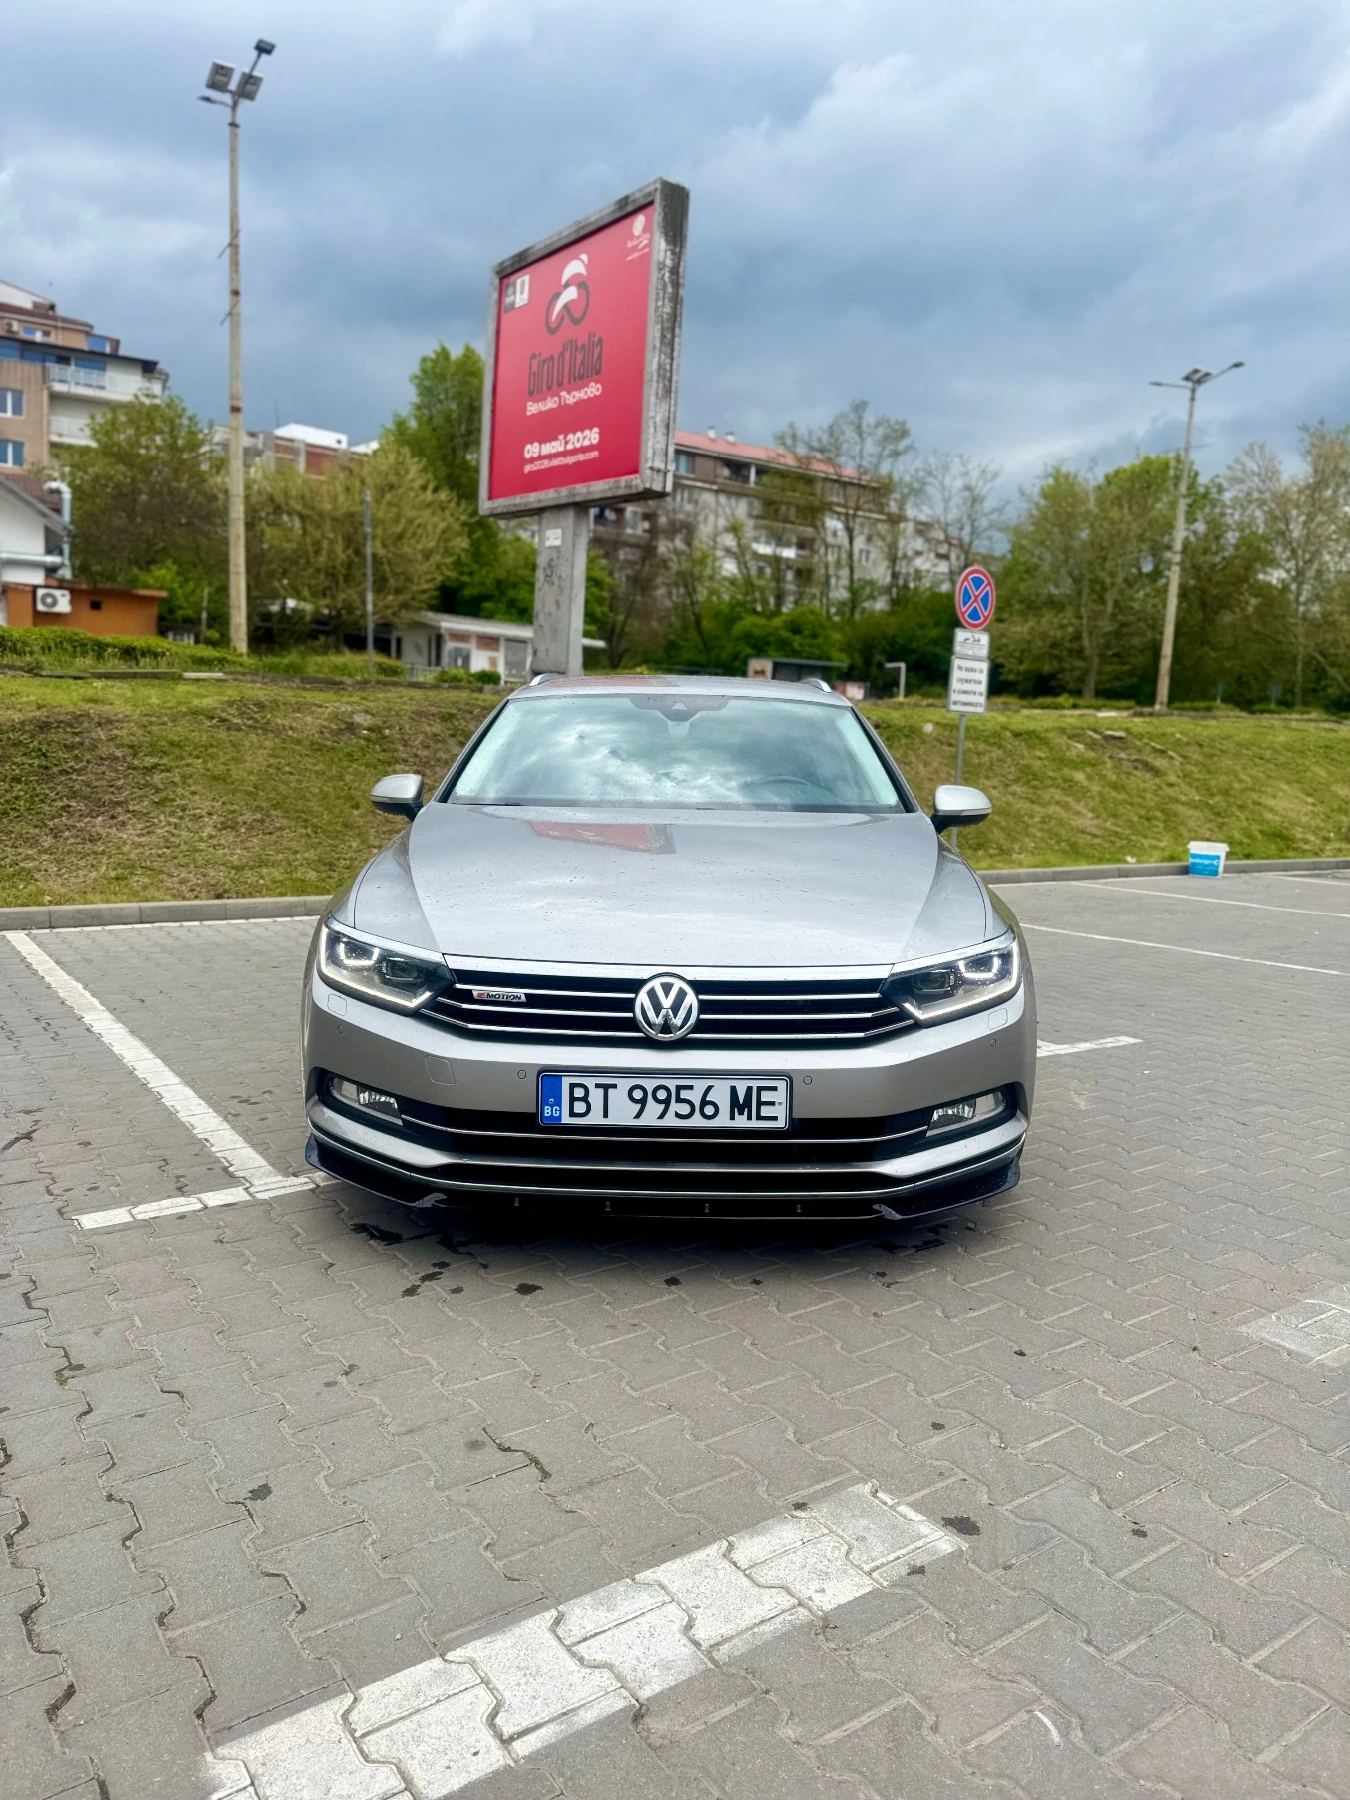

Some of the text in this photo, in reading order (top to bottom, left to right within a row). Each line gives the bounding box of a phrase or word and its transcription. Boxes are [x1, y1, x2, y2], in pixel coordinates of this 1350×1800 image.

[528, 352, 554, 397] Giro
[526, 382, 602, 416] Велико Търново
[524, 427, 600, 459] 09 май 2026
[544, 1105, 560, 1117] BG
[568, 1082, 779, 1121] BT 9956 ME
